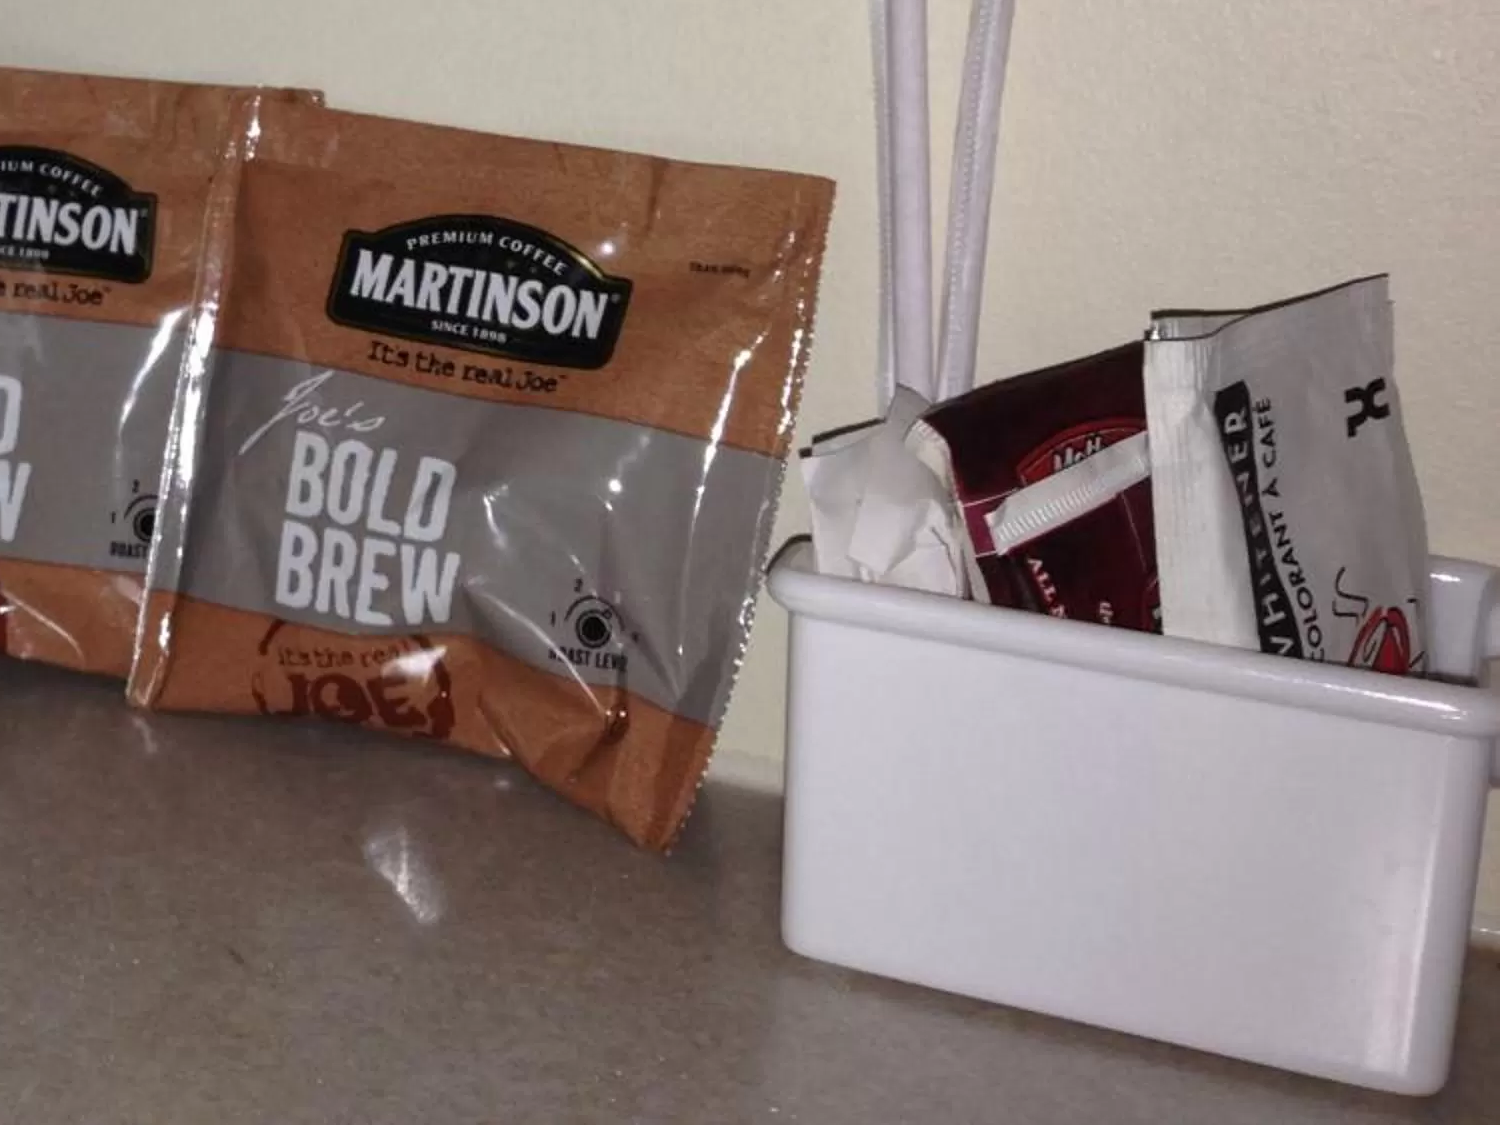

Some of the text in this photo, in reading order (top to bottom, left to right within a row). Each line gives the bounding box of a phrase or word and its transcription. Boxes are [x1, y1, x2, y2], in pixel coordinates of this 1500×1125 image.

[40, 163, 104, 197] COFFEE
[406, 231, 569, 276] PREMIUM COFFEE
[14, 281, 58, 302] real
[350, 249, 609, 339] MARTINSON
[431, 319, 469, 336] SINCE
[368, 340, 558, 393] It's the real Joe
[238, 369, 386, 456] Joe's
[285, 430, 456, 542] BOLD
[275, 520, 460, 625] BREW
